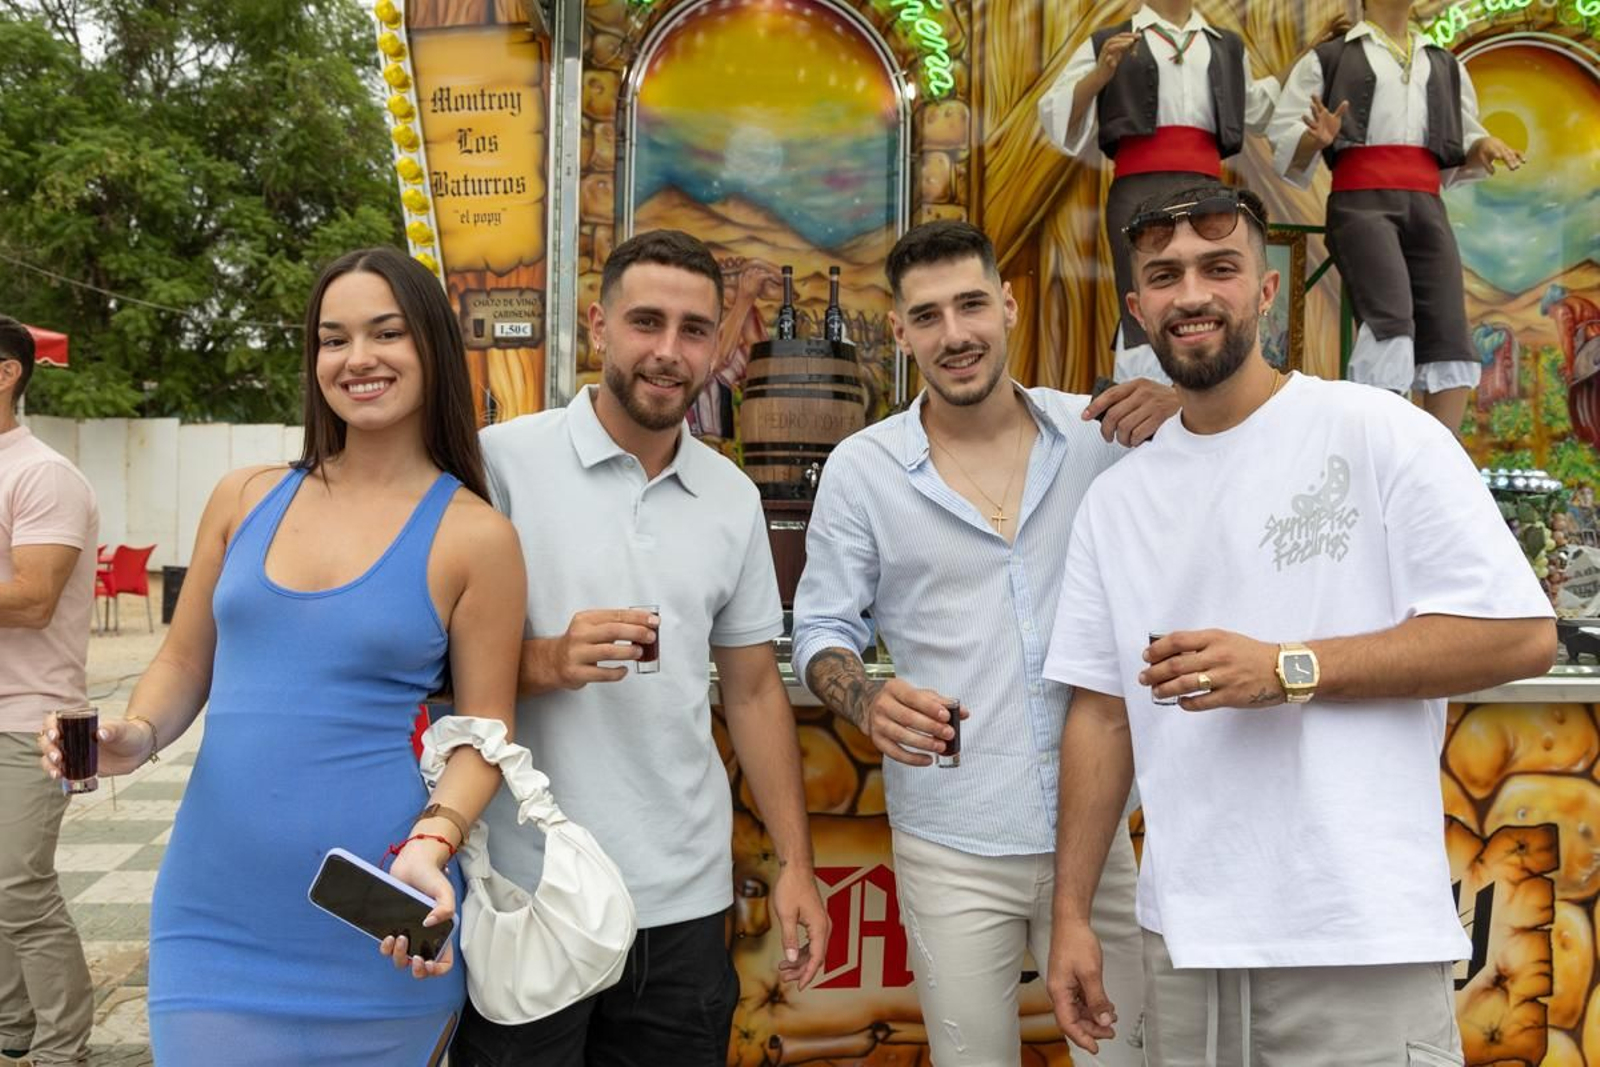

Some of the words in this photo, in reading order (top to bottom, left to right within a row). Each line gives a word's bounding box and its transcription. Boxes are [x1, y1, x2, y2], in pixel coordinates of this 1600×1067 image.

[430, 86, 521, 117] Montroy
[457, 127, 498, 154] Los
[432, 171, 526, 197] Baturros
[503, 298, 513, 307] DE
[516, 298, 537, 307] VINO
